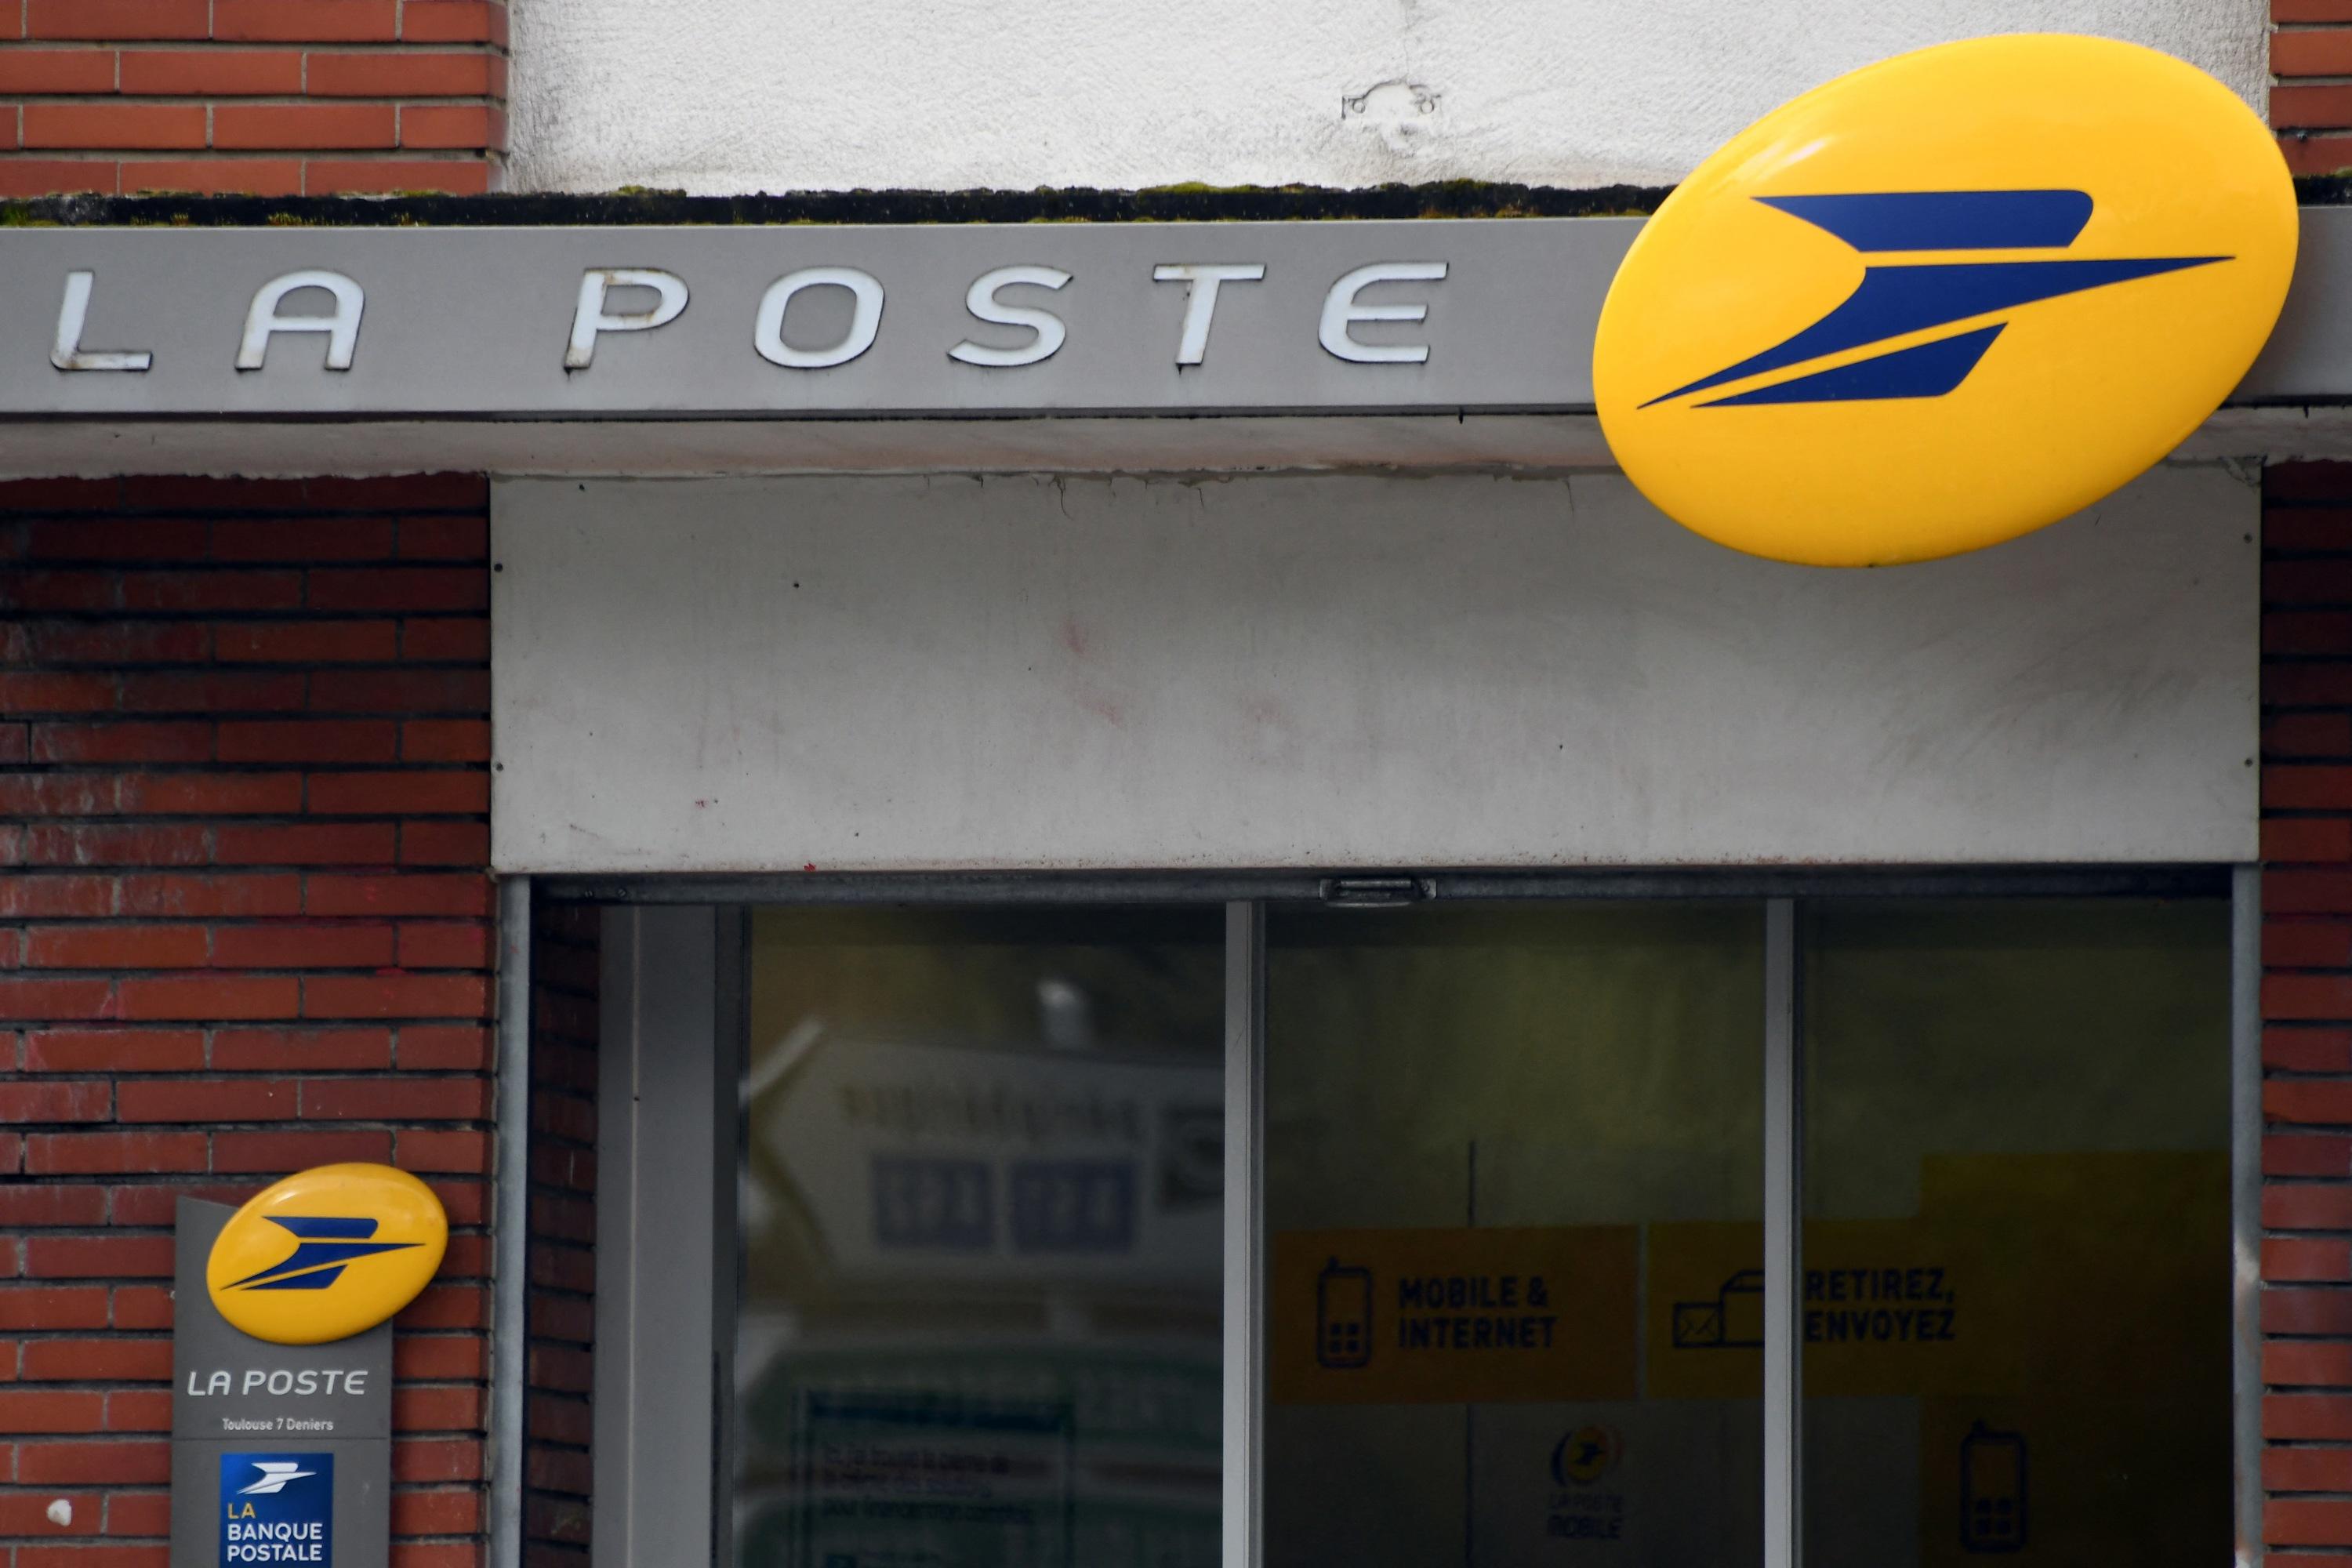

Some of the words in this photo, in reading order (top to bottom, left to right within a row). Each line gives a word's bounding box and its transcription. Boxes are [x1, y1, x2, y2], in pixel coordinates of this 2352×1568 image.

[49, 268, 365, 372] LA
[562, 262, 1450, 370] POSTE
[1398, 1275, 1519, 1309] MOBILE
[1526, 1275, 1548, 1308] &
[1805, 1266, 1955, 1303] RETIREZ,
[1398, 1316, 1558, 1348] INTERNET
[1804, 1308, 1955, 1342] ENVOYEZ
[187, 1370, 231, 1396] LA
[241, 1370, 368, 1396] POSTE
[222, 1417, 273, 1431] Toulouse
[276, 1417, 283, 1431] 7
[286, 1417, 334, 1431] Deniers
[227, 1502, 256, 1519] LA
[227, 1523, 323, 1542] BANQUE
[227, 1544, 323, 1563] POSTALE
